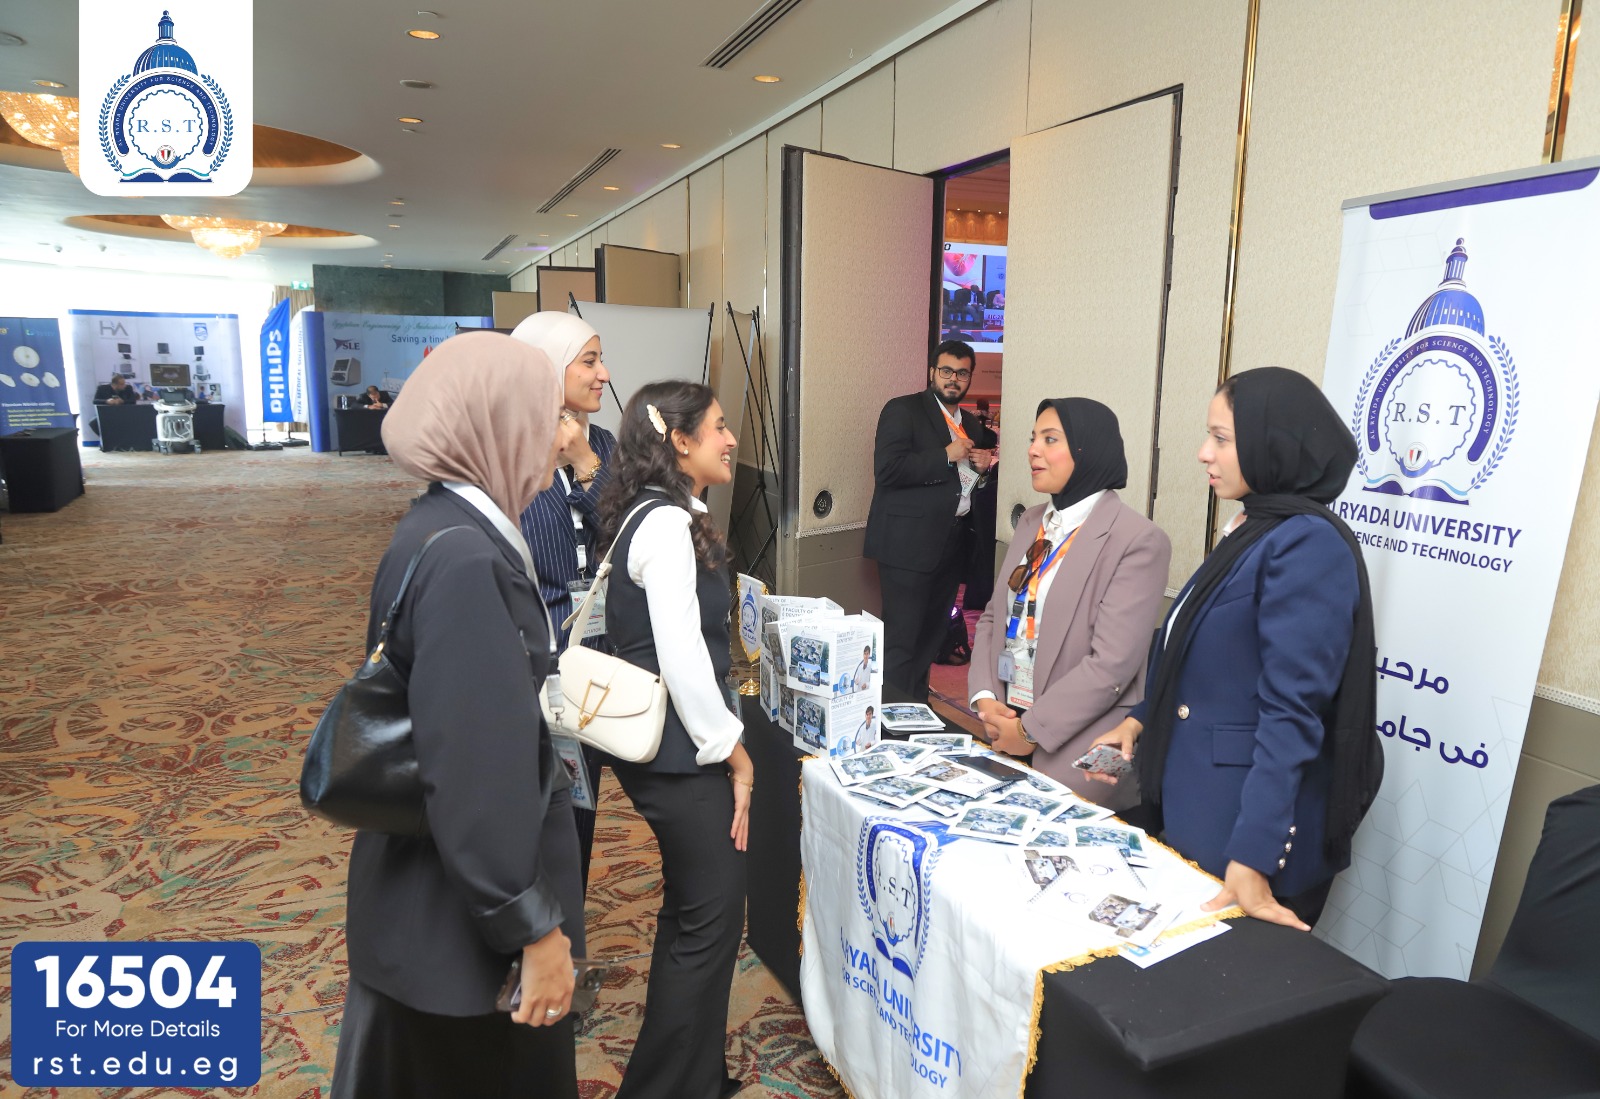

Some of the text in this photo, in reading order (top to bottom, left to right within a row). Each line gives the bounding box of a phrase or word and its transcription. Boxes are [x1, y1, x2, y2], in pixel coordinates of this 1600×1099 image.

[342, 342, 361, 350] SLE
[391, 334, 420, 345] Saving
[266, 328, 286, 414] PHILIPS
[1369, 397, 1379, 425] RYADA
[1378, 349, 1414, 393] UNIVERSITY
[1416, 341, 1429, 352] FOR
[1432, 340, 1468, 353] SCIENCE
[1469, 352, 1483, 368] AND
[1481, 368, 1494, 434] TECHNOLOGY
[1394, 510, 1522, 549] UNIVERSITY
[1384, 537, 1408, 554] AND
[1412, 542, 1513, 573] TECHNOLOGY
[1376, 657, 1449, 694] مرحب
[879, 1007, 897, 1030] AND
